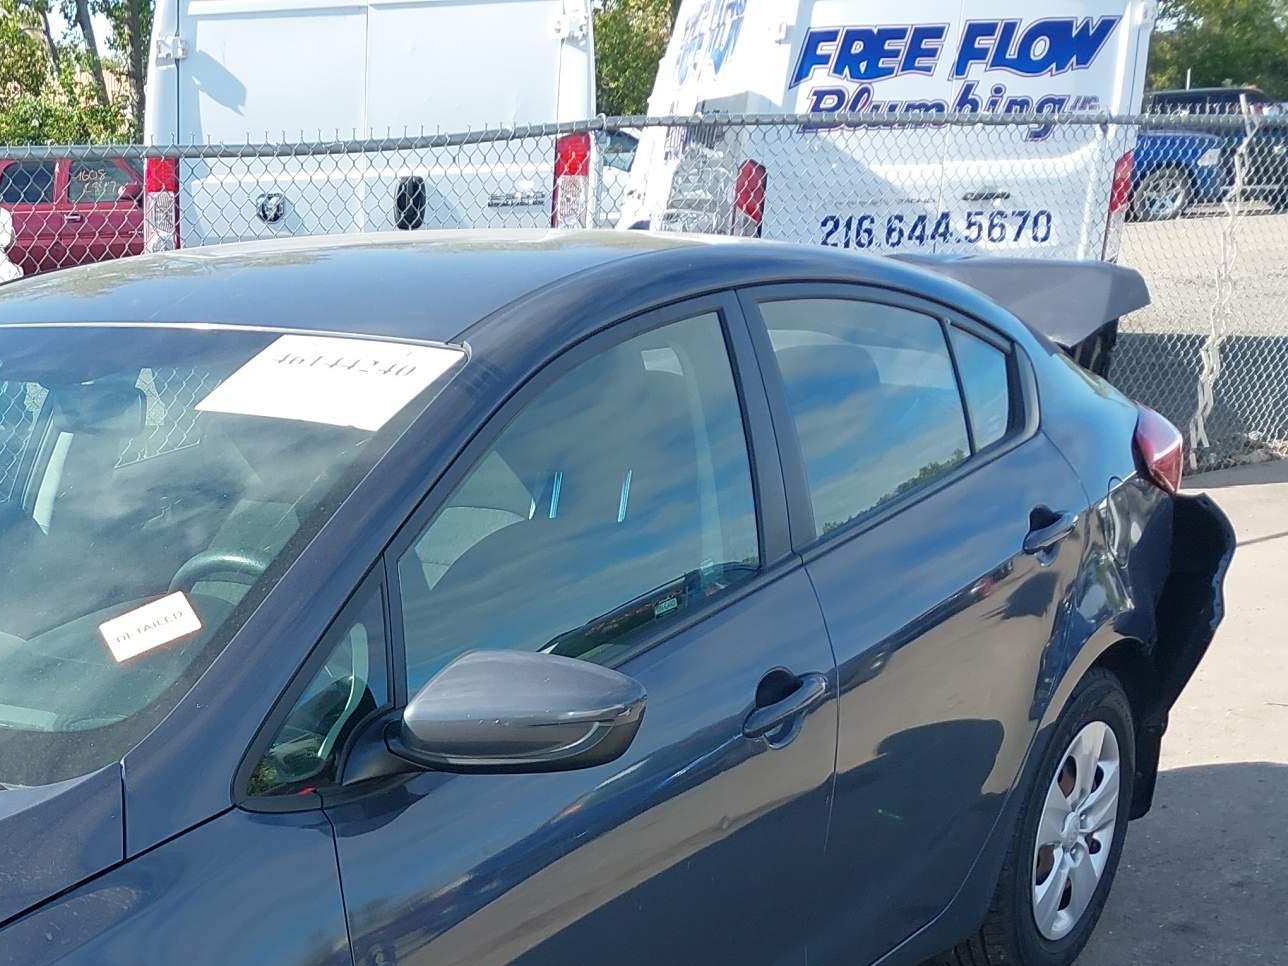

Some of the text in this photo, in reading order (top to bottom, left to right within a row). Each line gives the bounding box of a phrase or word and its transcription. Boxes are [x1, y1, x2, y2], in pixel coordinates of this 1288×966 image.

[789, 23, 949, 88] FREE
[949, 15, 1122, 80] FLOW
[819, 209, 1053, 249] 216.644.5670
